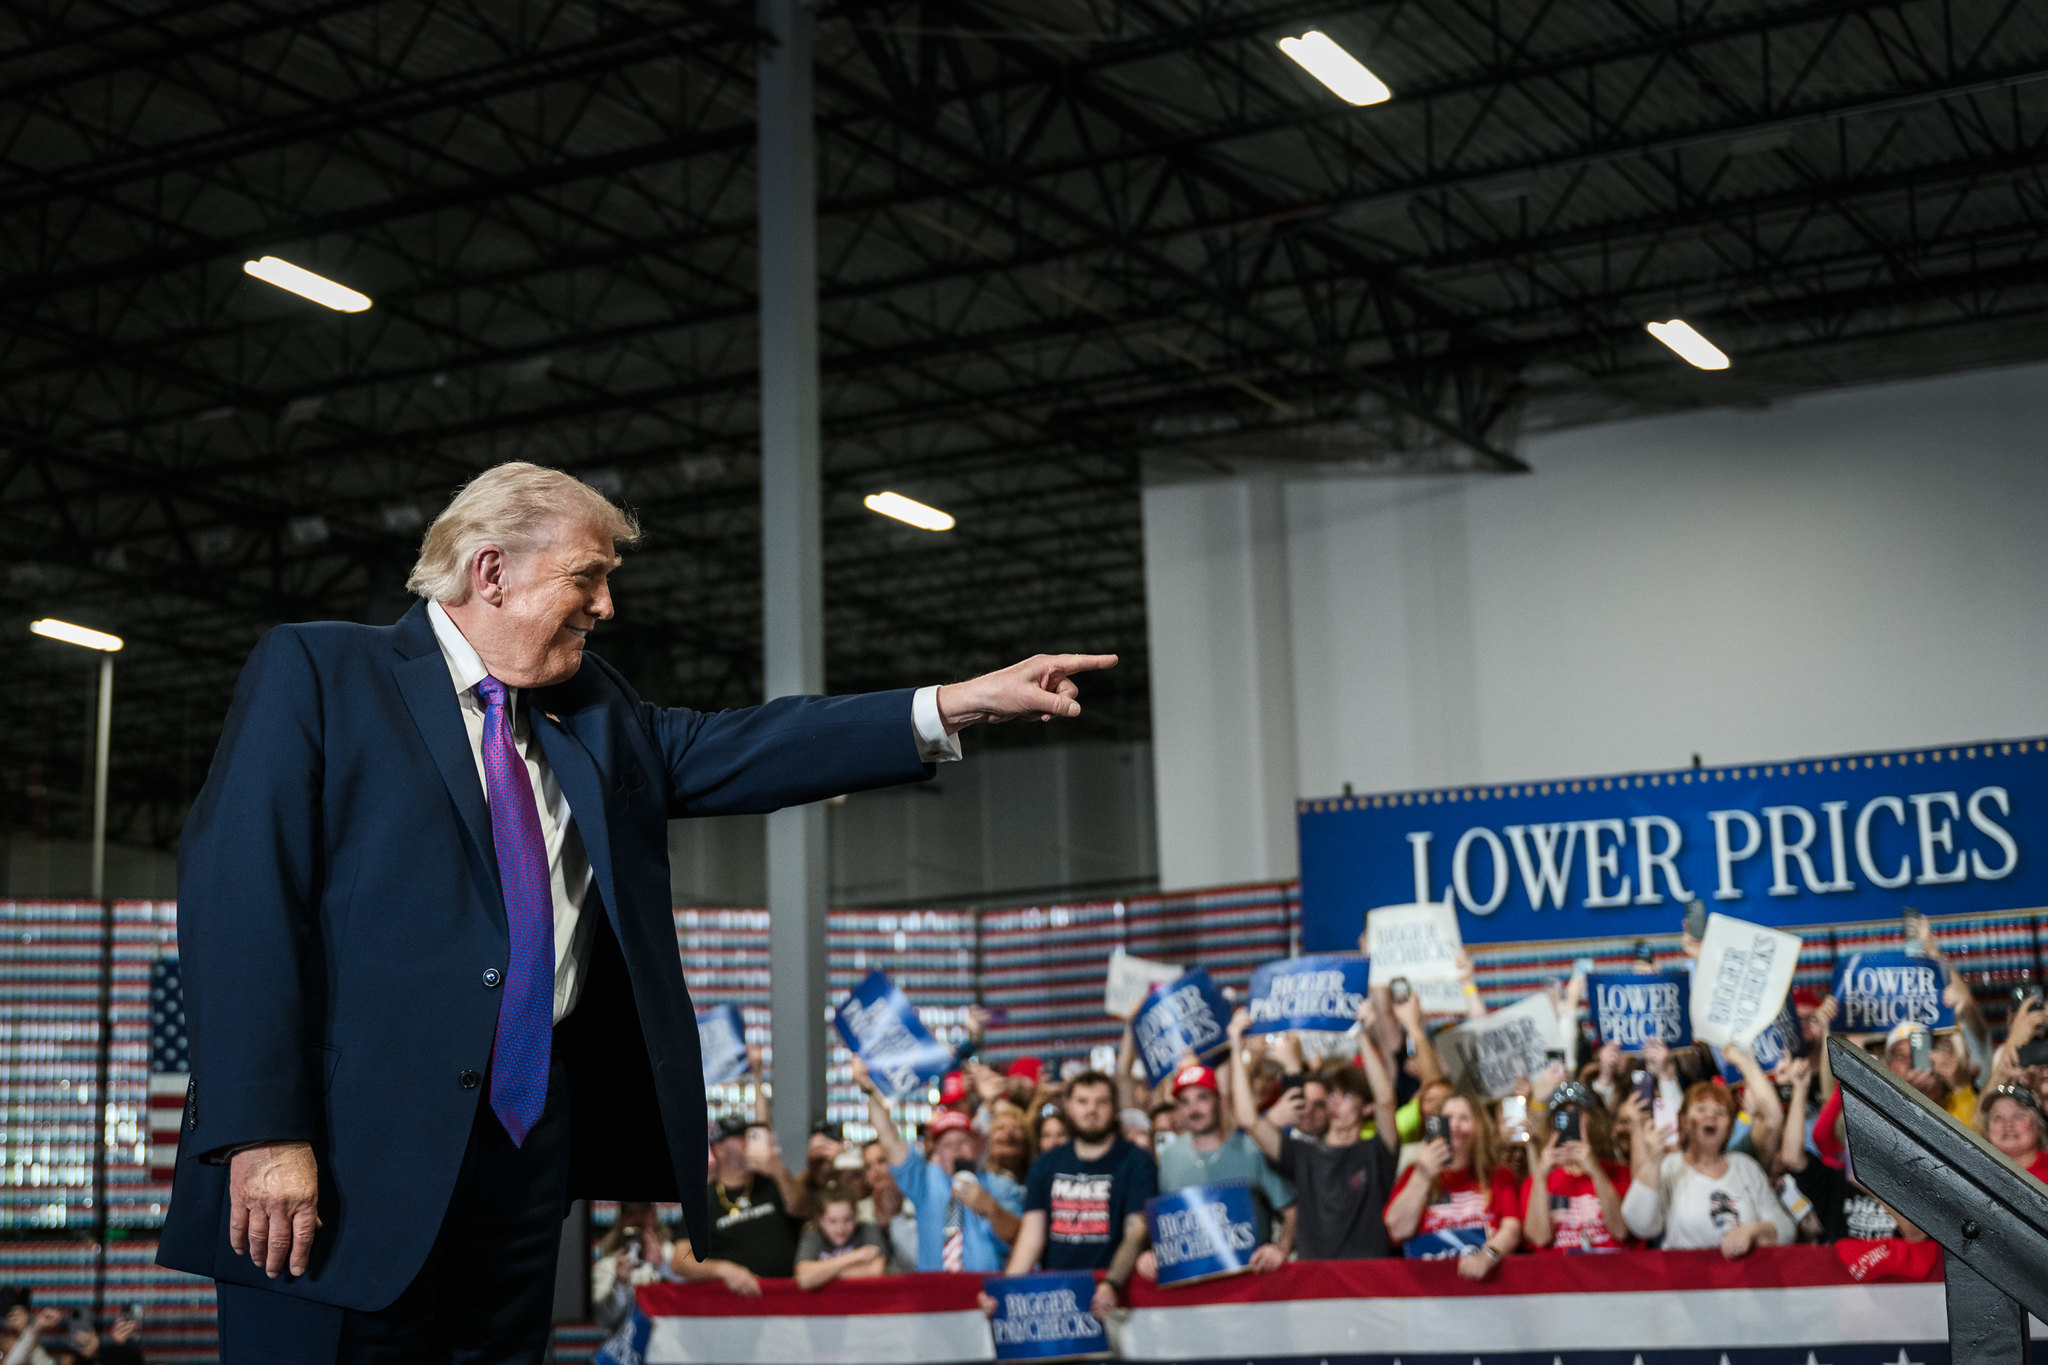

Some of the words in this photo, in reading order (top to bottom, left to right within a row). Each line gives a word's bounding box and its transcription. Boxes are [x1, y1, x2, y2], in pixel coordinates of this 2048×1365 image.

[1406, 814, 1695, 915] LOWER
[1707, 785, 2019, 900] PRICES
[1270, 970, 1346, 996] BIGGER
[1597, 983, 1681, 1013] LOWER
[1708, 946, 1748, 1025] BIGGER
[1844, 967, 1939, 997] LOWER
[1136, 984, 1208, 1048] LOWER
[1249, 992, 1362, 1022] PAYCHECKS
[1845, 994, 1940, 1027] PRICES
[1599, 1011, 1682, 1045] PRICES
[1005, 1289, 1080, 1317] BIGGER
[993, 1312, 1102, 1345] PAYCHECKS
